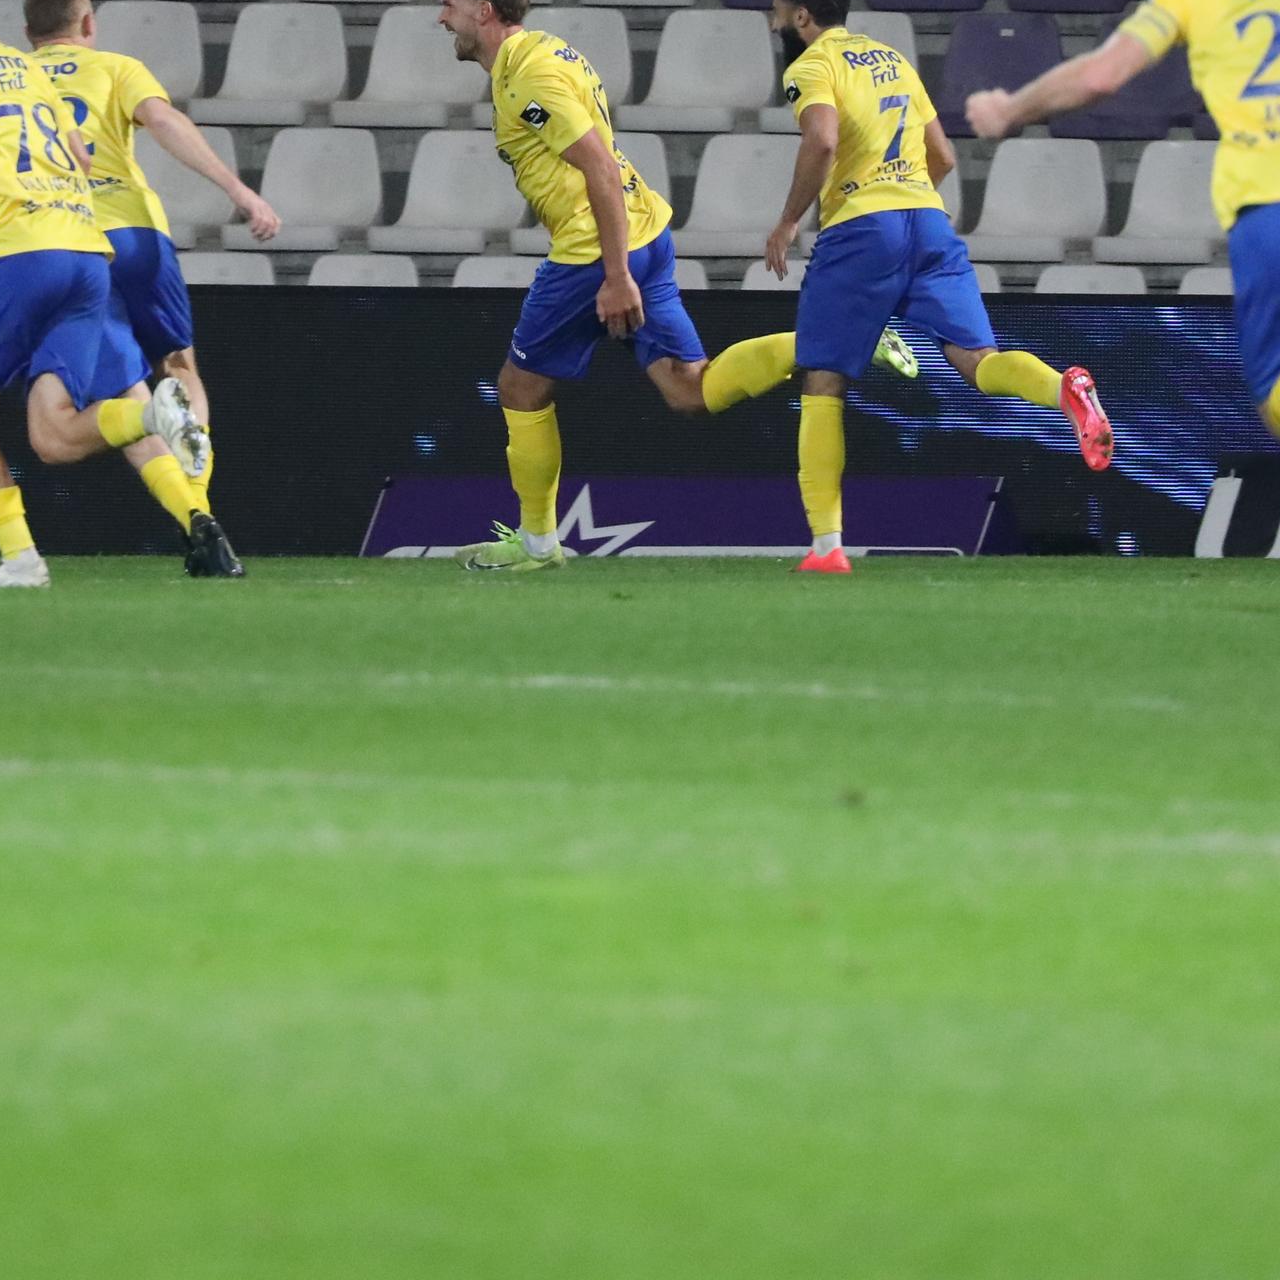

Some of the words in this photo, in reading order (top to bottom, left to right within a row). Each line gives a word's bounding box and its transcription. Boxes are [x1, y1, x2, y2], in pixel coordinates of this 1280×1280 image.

[842, 48, 902, 70] Remo
[871, 64, 900, 88] Frit
[878, 94, 910, 163] 7
